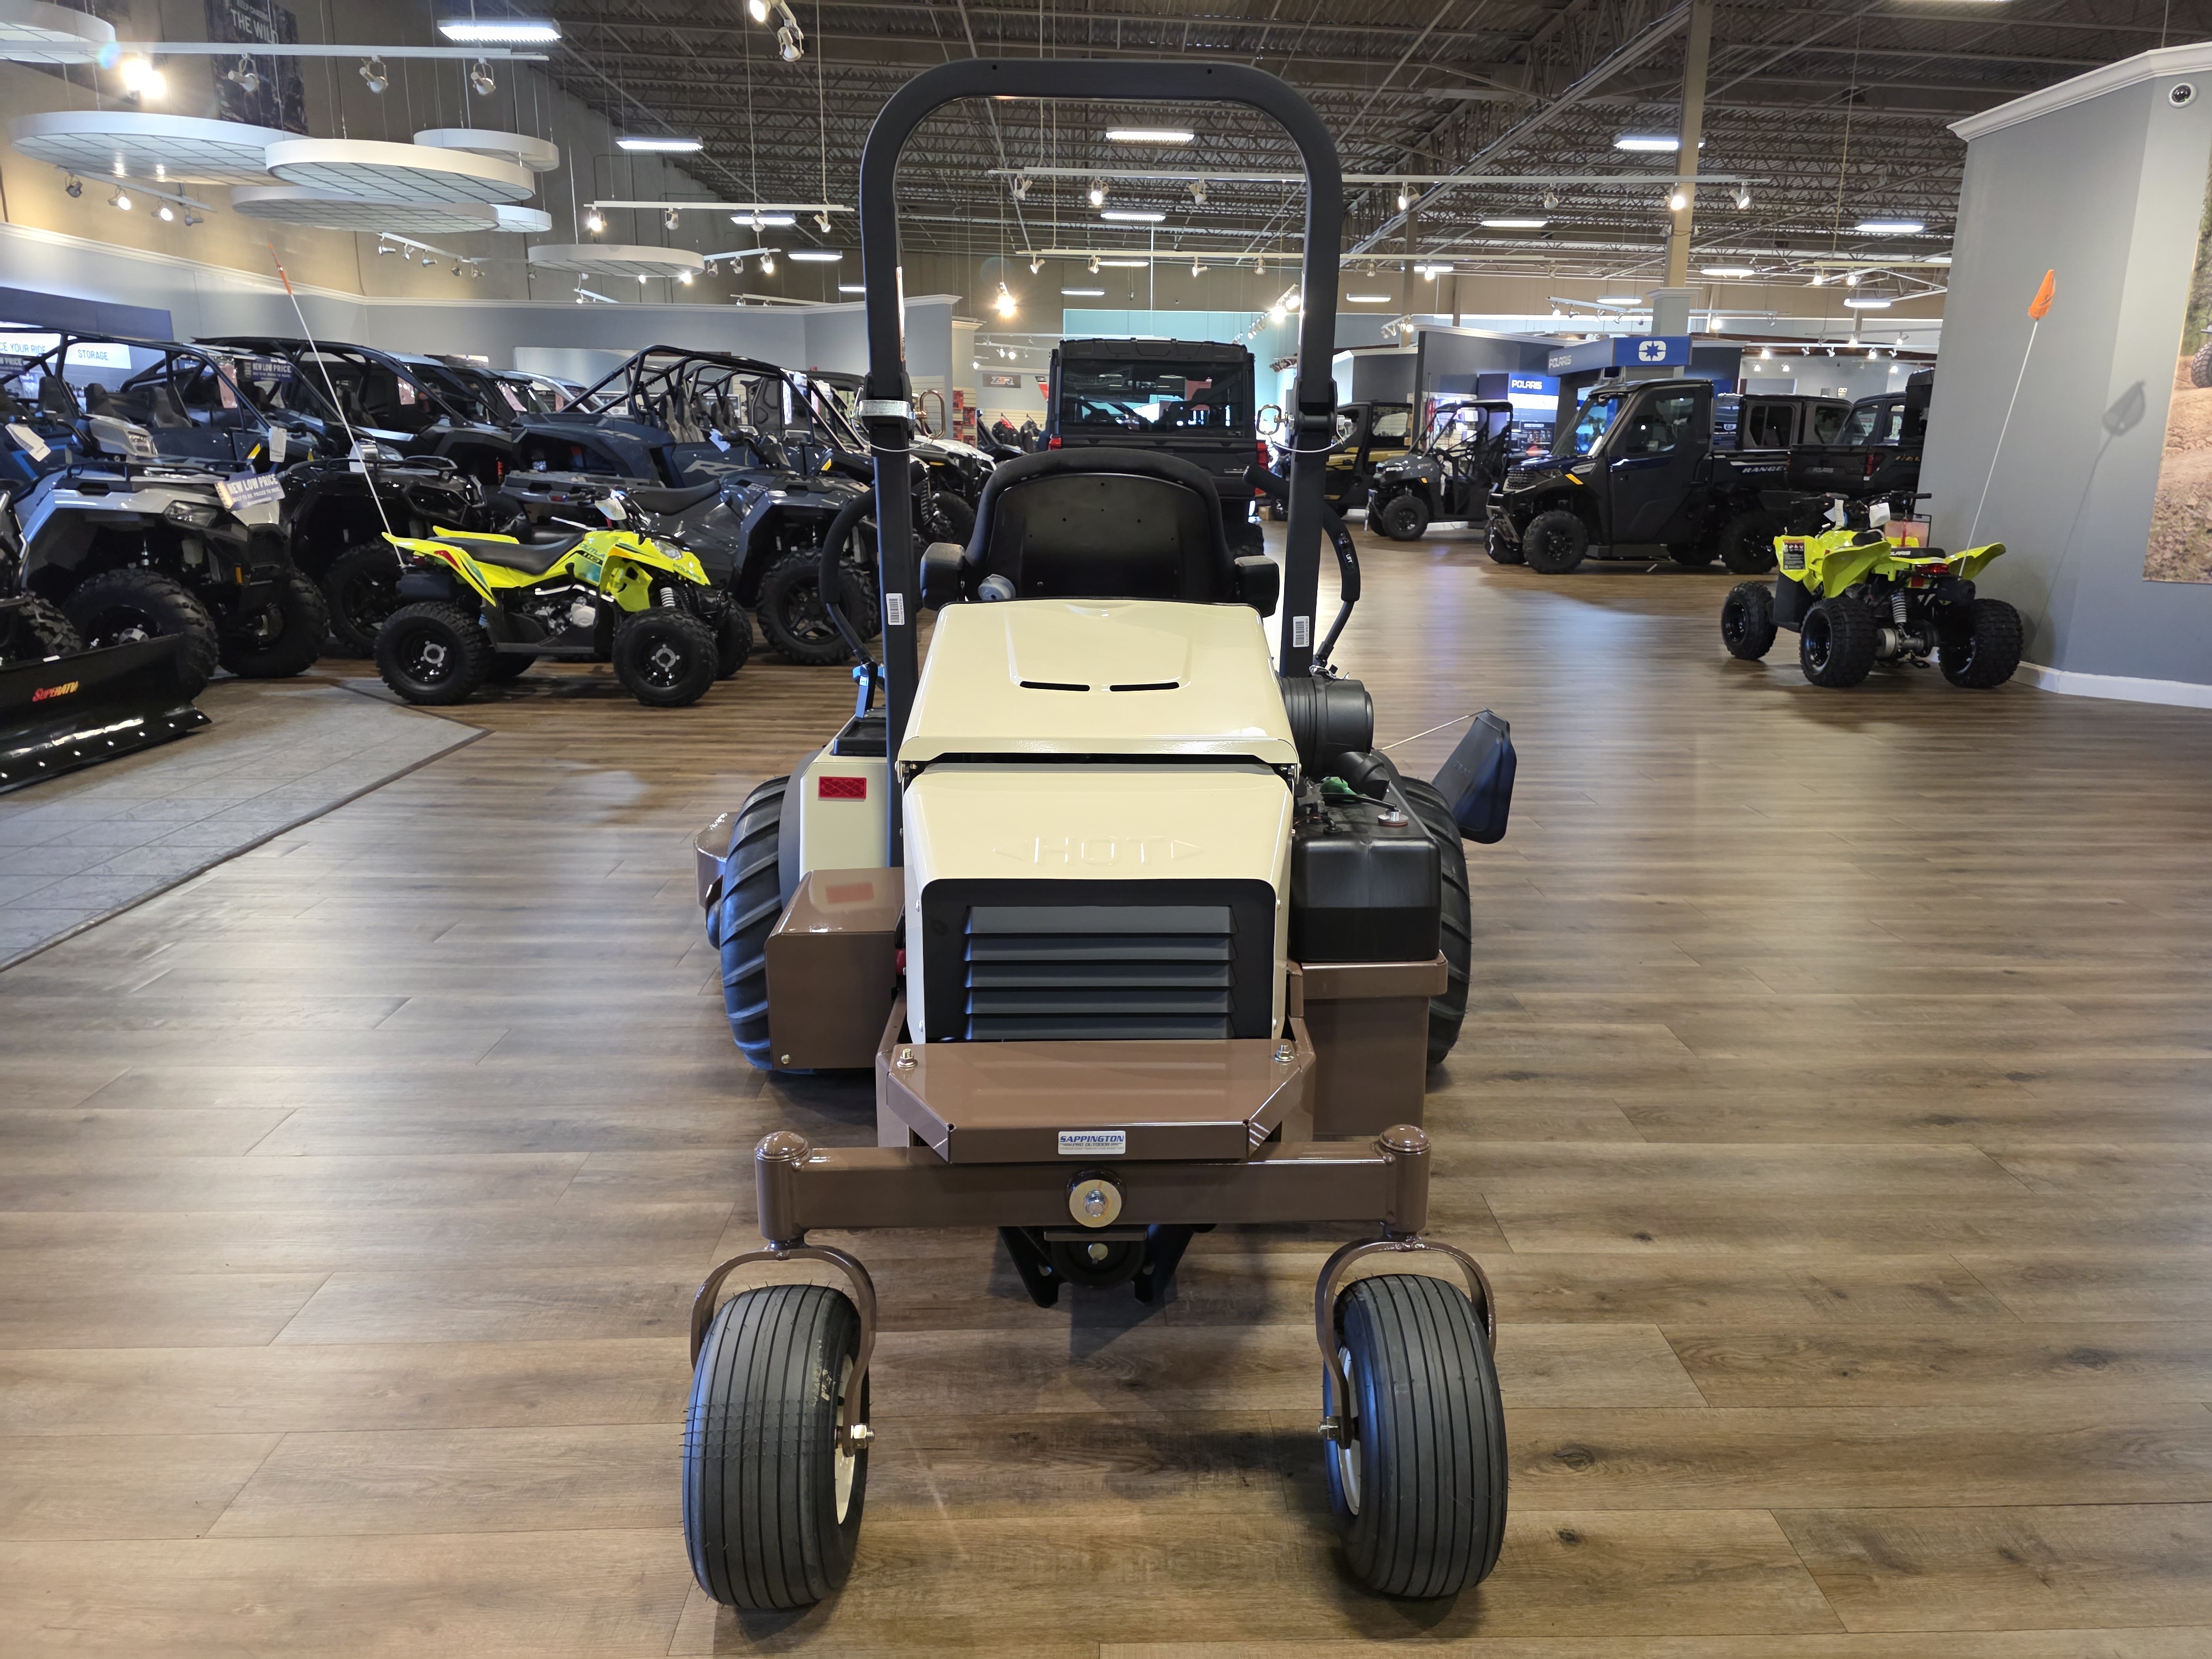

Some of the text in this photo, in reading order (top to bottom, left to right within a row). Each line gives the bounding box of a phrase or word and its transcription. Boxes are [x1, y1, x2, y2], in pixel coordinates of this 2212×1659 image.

[231, 9, 279, 44] THE WILD
[10, 343, 29, 353] YOUR
[31, 345, 46, 354] RIDE
[78, 349, 108, 361] STORAGE
[253, 362, 262, 371] NEW
[263, 363, 272, 372] LOW
[273, 364, 291, 373] PRICE
[1548, 355, 1572, 368] POLARIS
[1511, 379, 1542, 390] POLARIS
[227, 481, 243, 495] NEW
[243, 477, 258, 491] LOW
[258, 473, 278, 488] PRICE
[579, 543, 606, 559] OUTLA
[583, 552, 600, 563] 110
[673, 562, 702, 581] POLARIS
[1034, 836, 1165, 866] HOT
